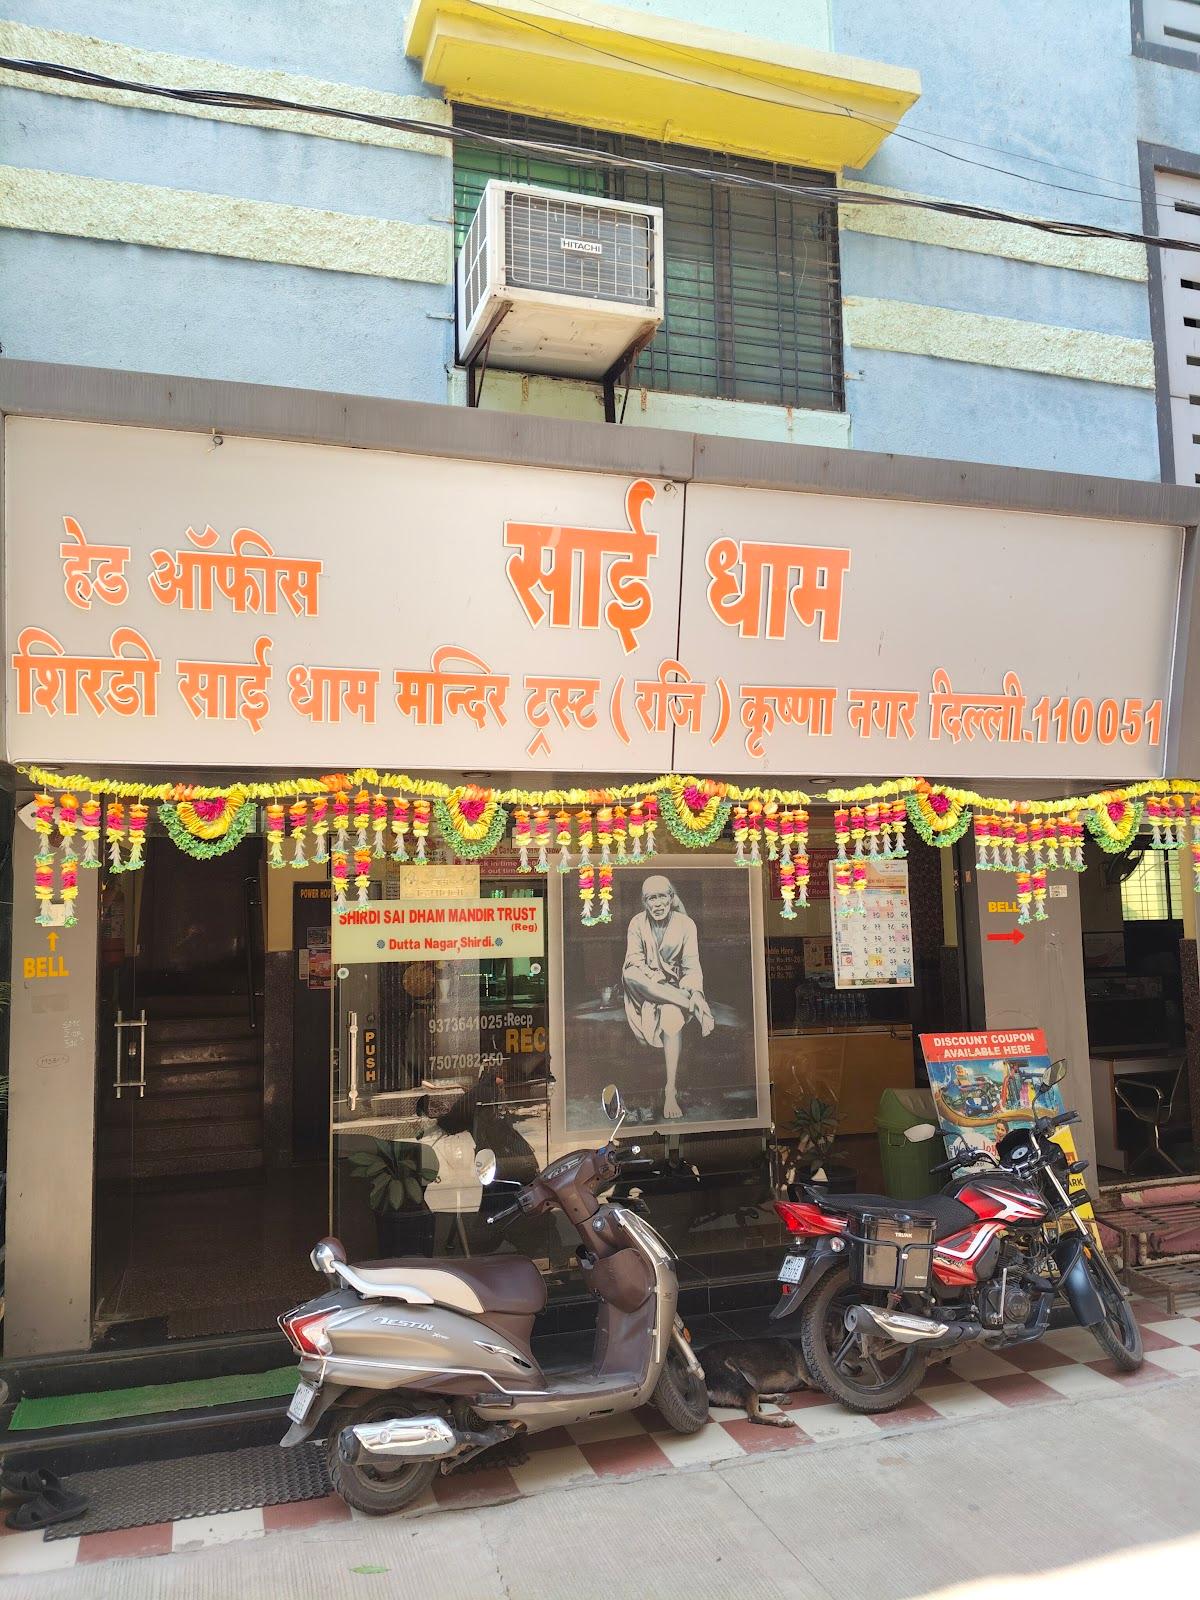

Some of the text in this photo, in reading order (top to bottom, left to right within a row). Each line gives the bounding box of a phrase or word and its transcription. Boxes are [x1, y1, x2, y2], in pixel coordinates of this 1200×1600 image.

[563, 240, 601, 253] HITACHI
[60, 516, 323, 617] हेड ऑफीस
[504, 479, 851, 655] साई धाम
[12, 627, 162, 718] शिरडी
[176, 635, 274, 734] साई
[287, 666, 381, 725] धाम
[394, 645, 512, 730] मन्दिर
[524, 675, 602, 756] ट्रस्ट
[740, 686, 839, 759] कृष्णा
[848, 689, 920, 740] नगर
[988, 900, 1021, 913] BELL
[338, 906, 537, 926] SHIRDI SAI DHAM MANDIR TRUST
[511, 922, 539, 933] (Reg)
[388, 938, 421, 951] Dutta
[23, 956, 69, 979] BELL
[933, 1032, 1035, 1047] DISCOUNT COUPON
[365, 1030, 377, 1082] PUSH
[943, 1044, 1032, 1059] AVAILABLE HERE
